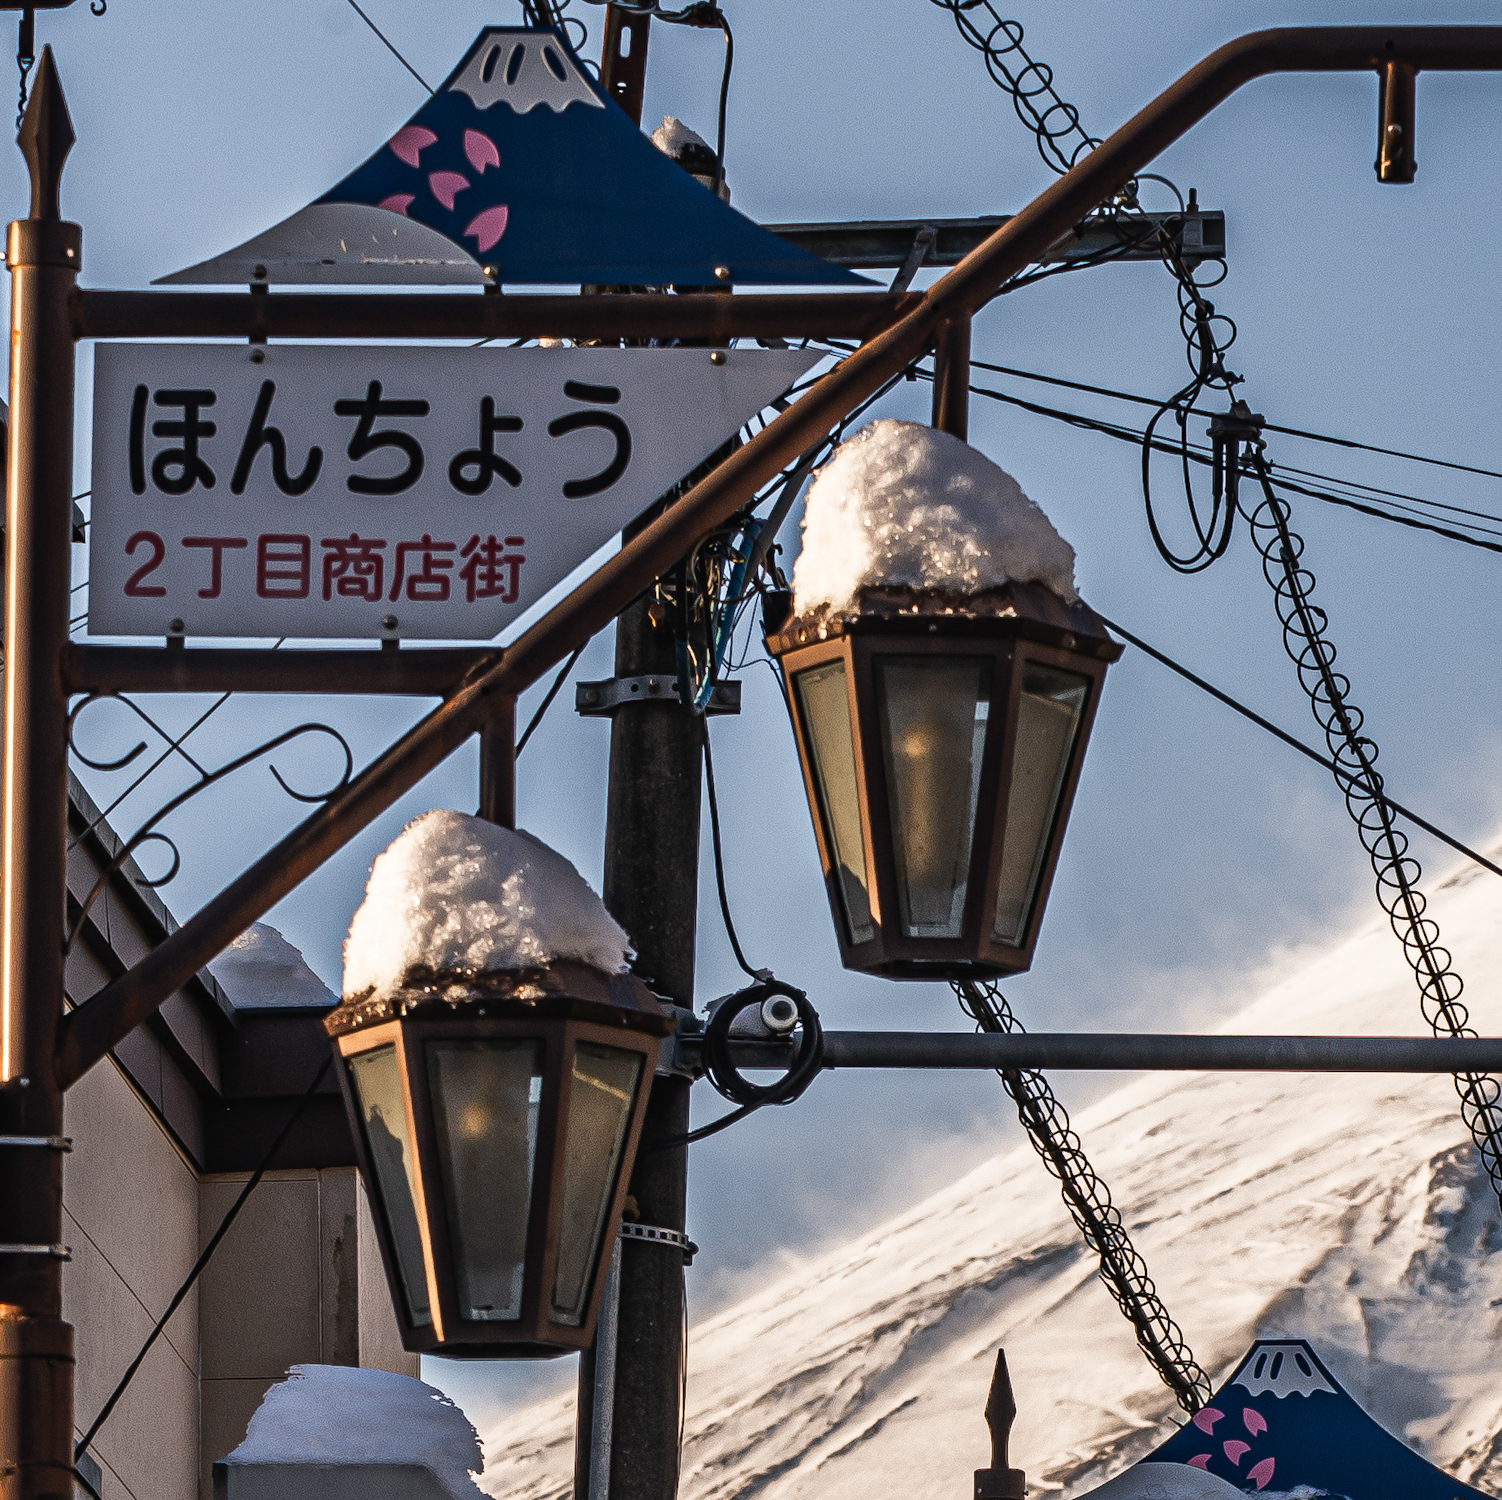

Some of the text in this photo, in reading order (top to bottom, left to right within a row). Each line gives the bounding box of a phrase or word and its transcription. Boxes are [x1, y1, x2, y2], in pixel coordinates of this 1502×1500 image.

[128, 380, 632, 498] ほんちょう
[123, 531, 525, 605] 2丁目商店街
